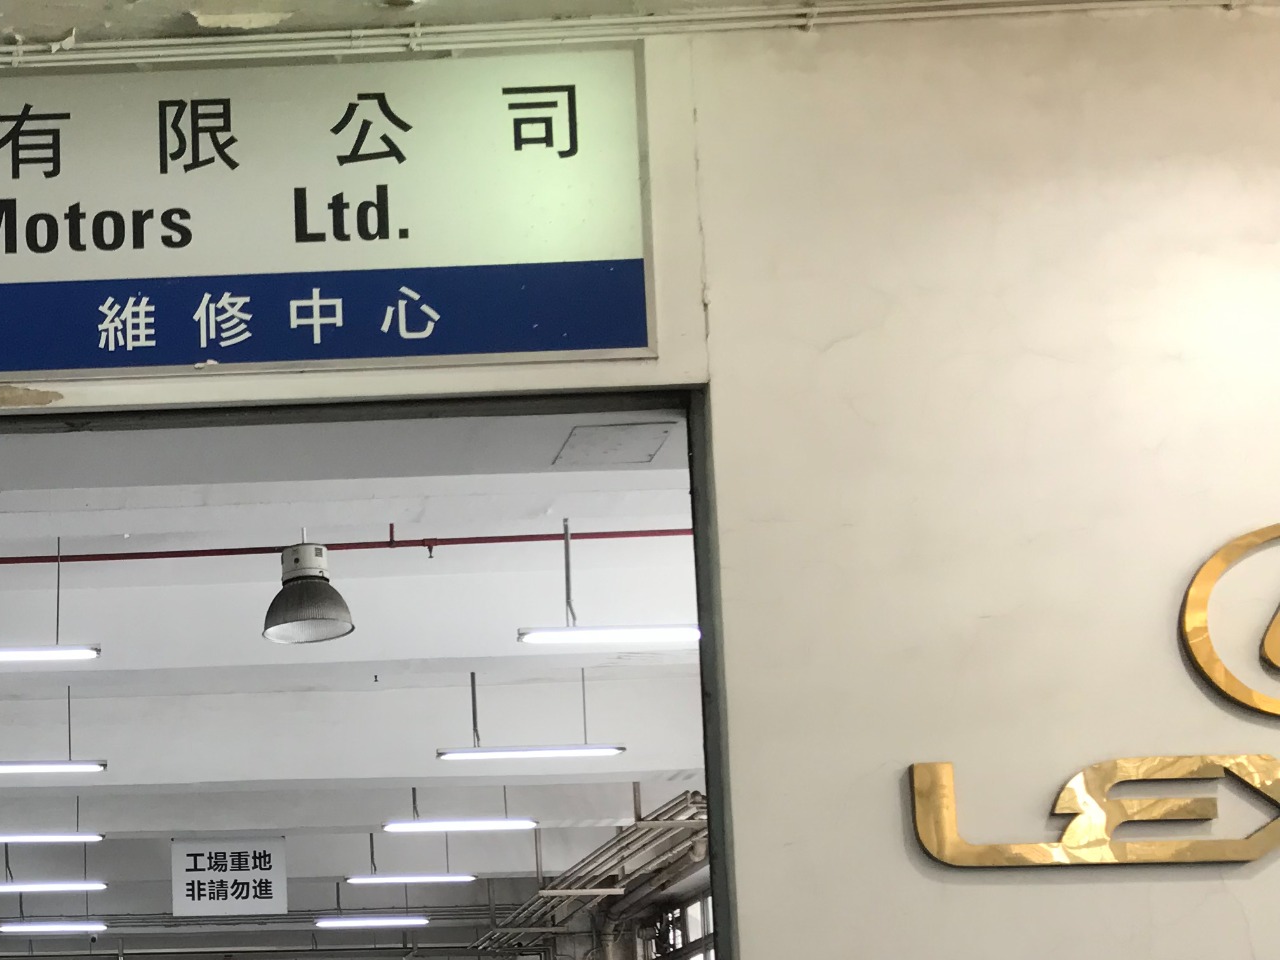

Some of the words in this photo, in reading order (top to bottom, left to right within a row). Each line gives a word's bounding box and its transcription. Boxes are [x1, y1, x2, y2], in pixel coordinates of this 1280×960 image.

[292, 184, 410, 243] Ltd.
[97, 285, 441, 352] 維修中心
[185, 850, 273, 872] 工場重地
[185, 878, 273, 901] 非請勿進
